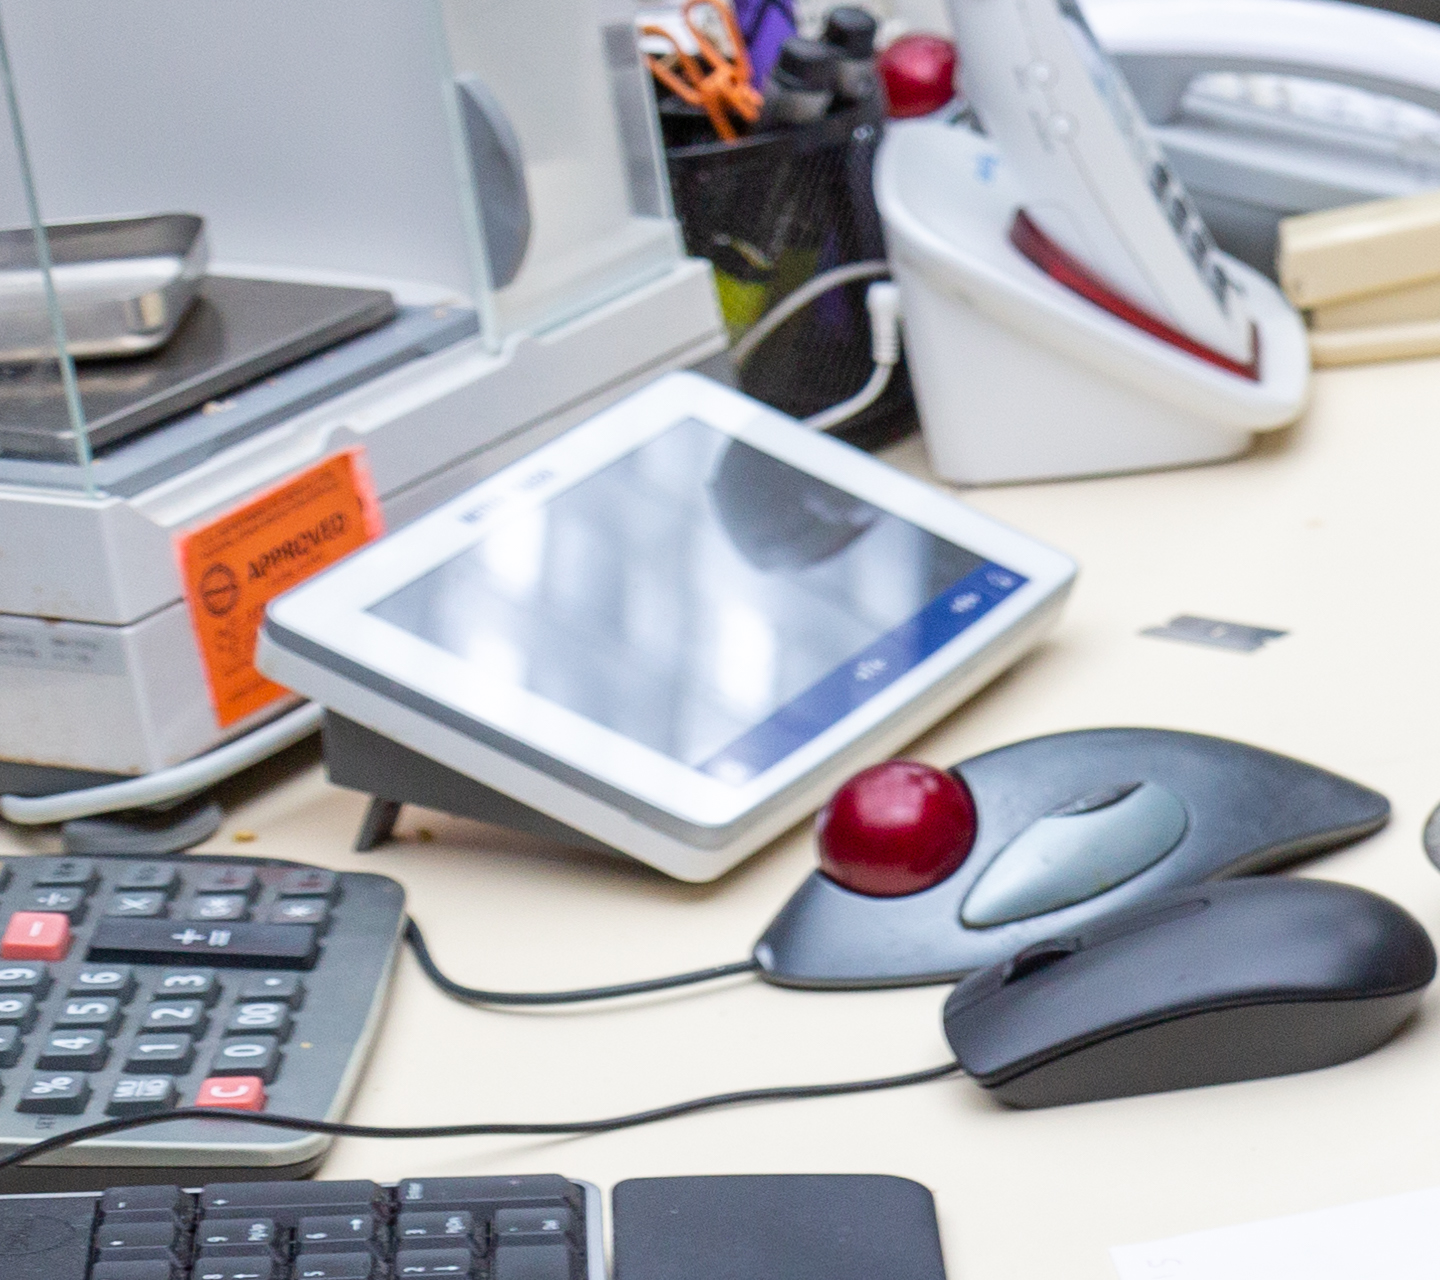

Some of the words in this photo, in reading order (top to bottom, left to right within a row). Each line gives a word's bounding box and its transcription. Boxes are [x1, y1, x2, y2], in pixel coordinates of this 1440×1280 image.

[247, 510, 347, 580] APPROVED
[0, 968, 36, 981] 9
[80, 970, 120, 984] 6
[164, 975, 206, 988] 3
[67, 1002, 107, 1016] 5
[151, 1006, 194, 1019] 2
[237, 1002, 280, 1026] 00
[52, 1037, 94, 1051] 4
[139, 1043, 180, 1053] 1
[223, 1044, 267, 1058] 0
[33, 1077, 72, 1095] %
[211, 1086, 250, 1098] C
